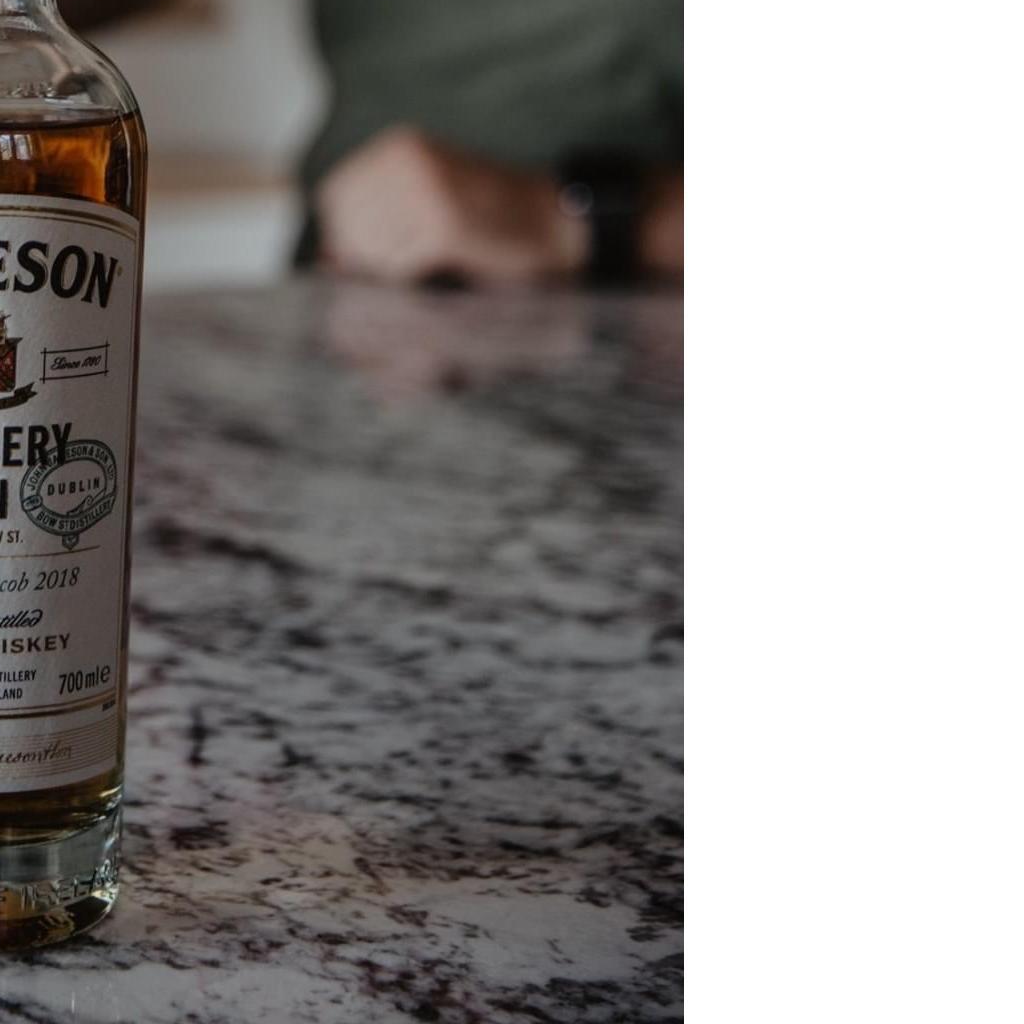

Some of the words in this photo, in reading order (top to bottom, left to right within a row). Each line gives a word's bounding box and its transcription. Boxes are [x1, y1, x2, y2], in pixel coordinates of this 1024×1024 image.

[48, 444, 89, 467] JAESON
[47, 477, 100, 496] DUBLIN
[36, 511, 57, 527] BOW
[7, 530, 24, 543] ST.
[33, 567, 81, 592] 2018
